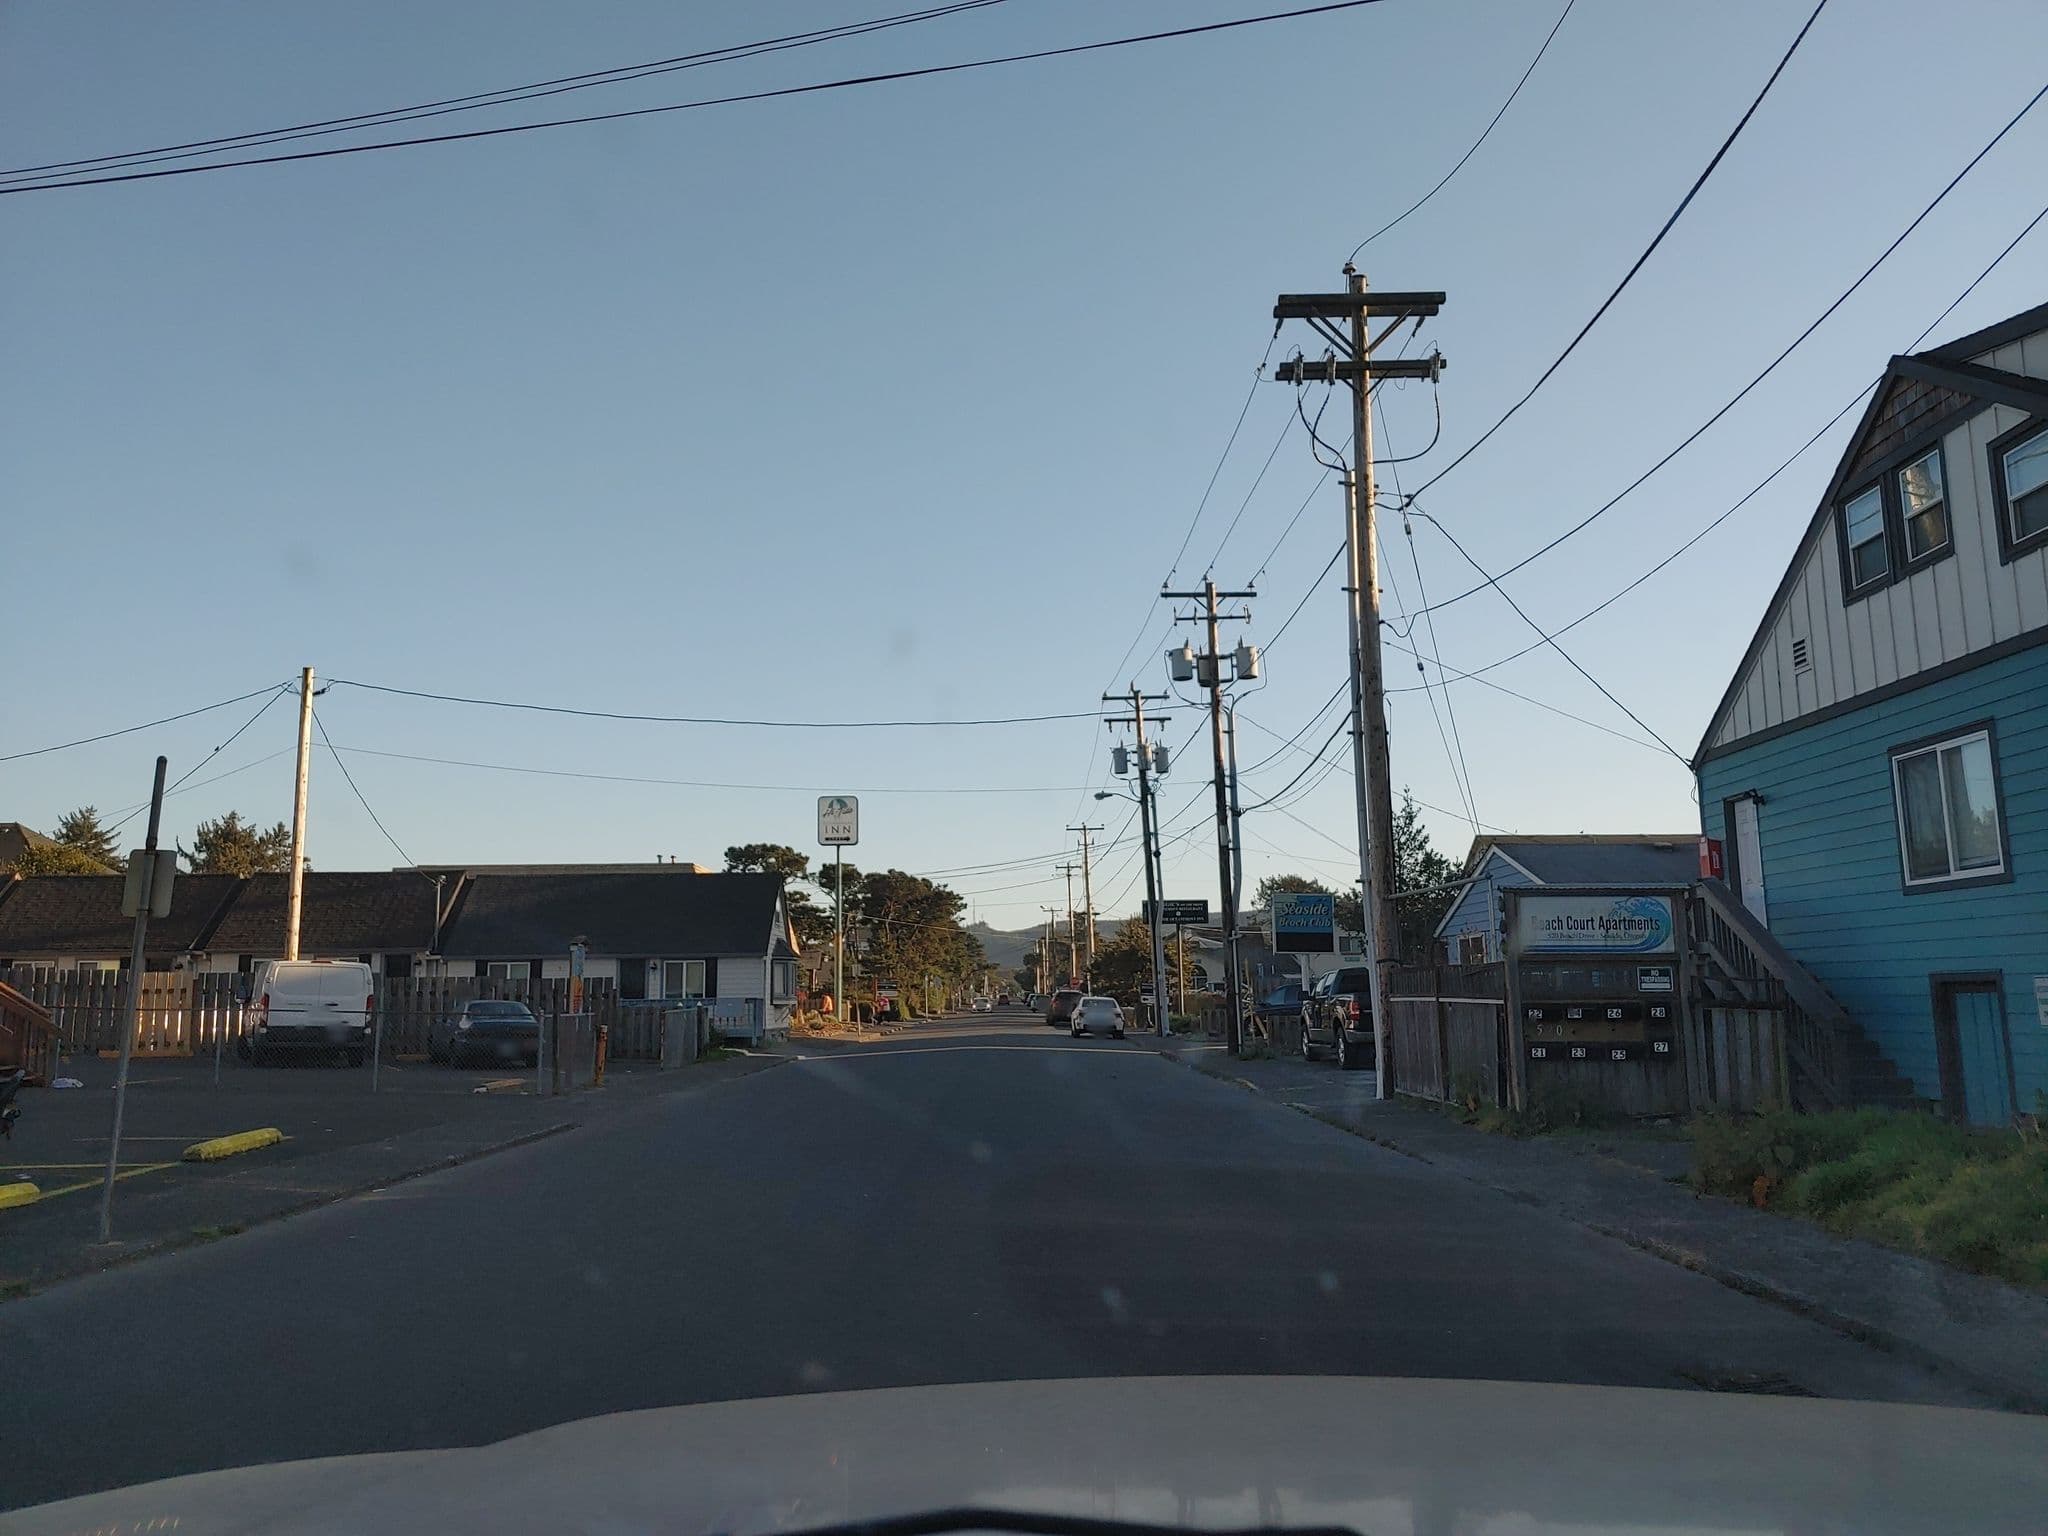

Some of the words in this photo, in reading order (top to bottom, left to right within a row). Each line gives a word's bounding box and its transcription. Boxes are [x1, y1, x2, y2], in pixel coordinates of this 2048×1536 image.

[824, 825, 851, 834] INN
[1280, 903, 1329, 916] Seaside
[1280, 917, 1307, 928] Beach
[1310, 917, 1332, 928] Club
[1566, 916, 1595, 931] Court
[1598, 916, 1660, 933] Apartments
[1651, 969, 1659, 977] NO
[1609, 1009, 1621, 1018] 26
[1652, 1008, 1665, 1017] 28
[1655, 1042, 1668, 1052] 27
[1532, 1049, 1545, 1057] 21
[1572, 1049, 1585, 1057] 23
[1612, 1050, 1625, 1060] 25
